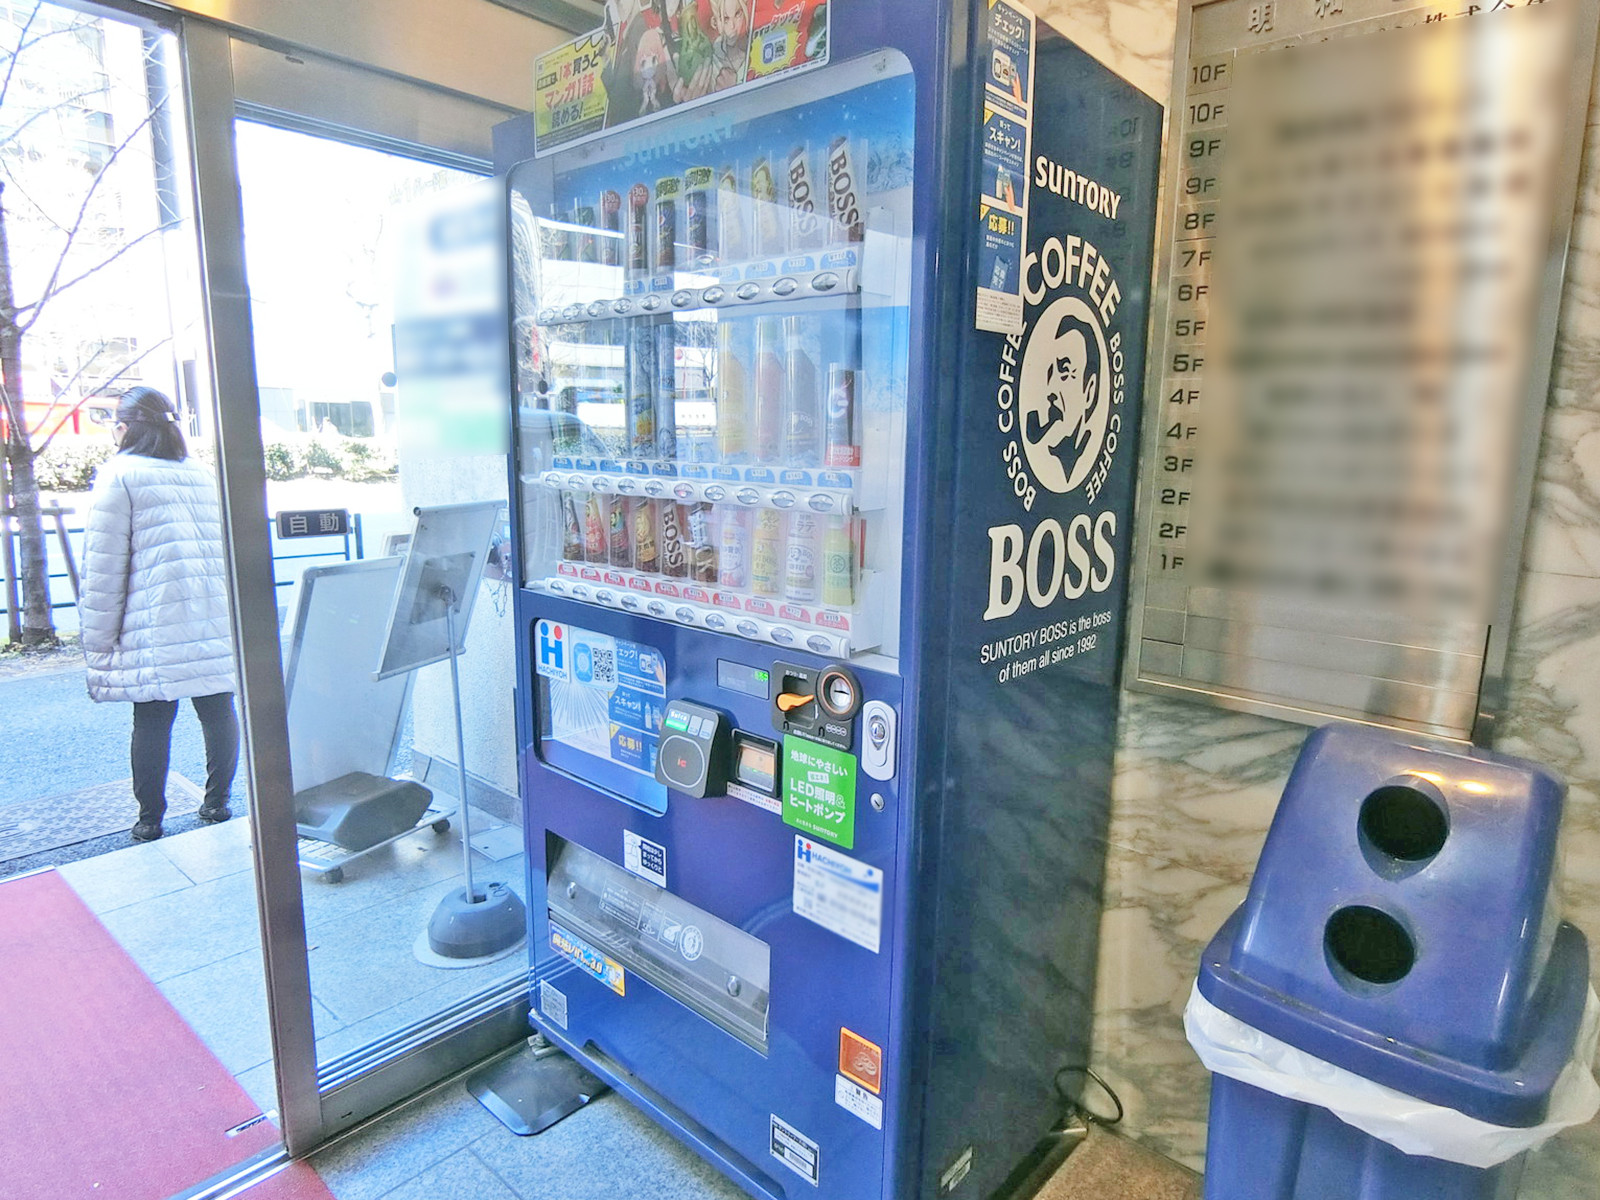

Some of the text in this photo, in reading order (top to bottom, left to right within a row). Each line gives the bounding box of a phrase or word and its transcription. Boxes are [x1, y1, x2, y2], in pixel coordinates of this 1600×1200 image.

[1191, 63, 1227, 84] 10F
[1189, 103, 1224, 124] 10F
[989, 126, 1021, 152] スキャン!
[1188, 138, 1221, 158] 9F
[831, 150, 859, 225] BOSS
[1035, 155, 1122, 220] SUNTORY
[1185, 177, 1217, 195] 9F
[790, 160, 818, 235] BOSS
[1184, 212, 1216, 231] 8F
[1181, 249, 1212, 268] 7F
[1023, 234, 1122, 328] COFFEE
[1178, 284, 1209, 302] 6F
[1175, 320, 1206, 337] 5F
[1173, 354, 1204, 373] 5F
[1169, 388, 1200, 405] 4F
[1085, 332, 1124, 505] BOSS COFFEE
[1166, 422, 1197, 440] 4F
[1163, 456, 1193, 473] 3F
[1003, 440, 1037, 512] BOSS
[1161, 488, 1191, 506] 2F
[289, 513, 339, 534] 自動
[1159, 523, 1187, 539] 2F
[664, 510, 684, 567] BOSS
[983, 511, 1116, 621] BOSS
[1160, 554, 1184, 570] 1F
[980, 610, 1111, 664] SUNTORY BOSS is the boss
[998, 633, 1097, 683] of them all since 1992
[791, 750, 848, 776] 地球にやさしい
[790, 793, 846, 824] ヒートポンプ
